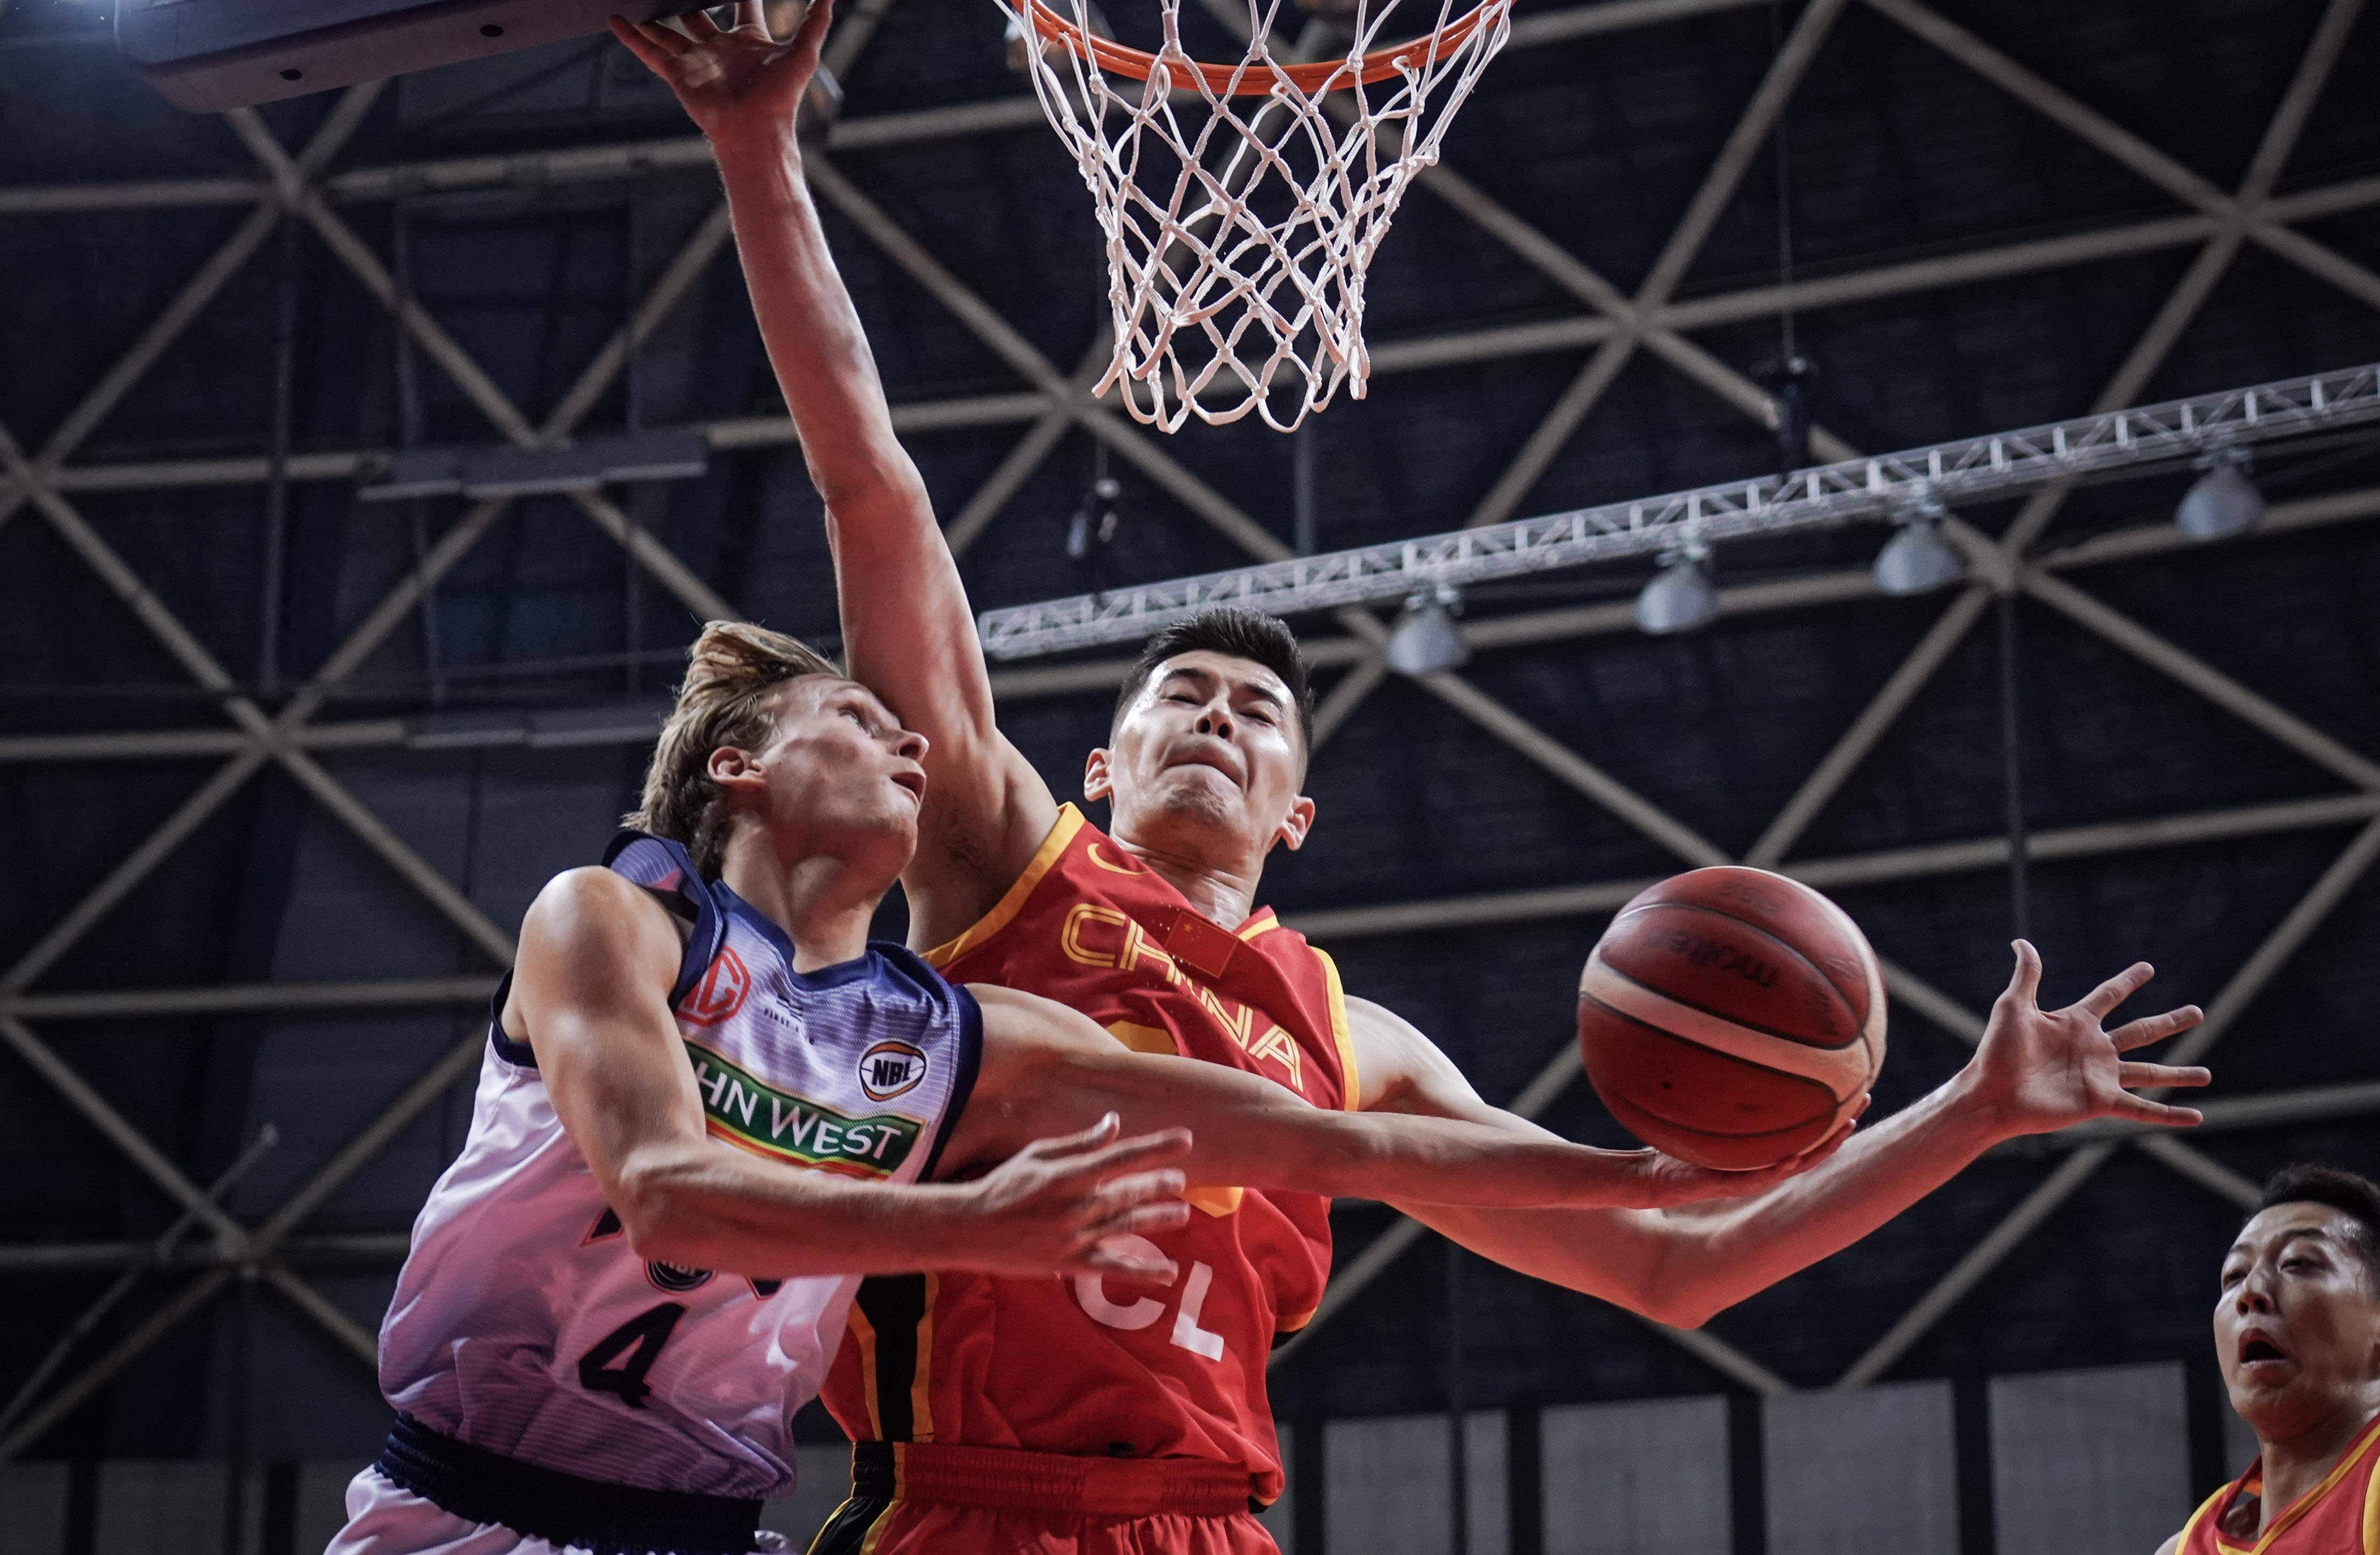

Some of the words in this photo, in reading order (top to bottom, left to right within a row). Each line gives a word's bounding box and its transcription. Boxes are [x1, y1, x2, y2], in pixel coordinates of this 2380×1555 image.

[871, 1059, 911, 1087] NBL
[771, 1097, 902, 1160] WEST
[577, 1301, 689, 1410] 4
